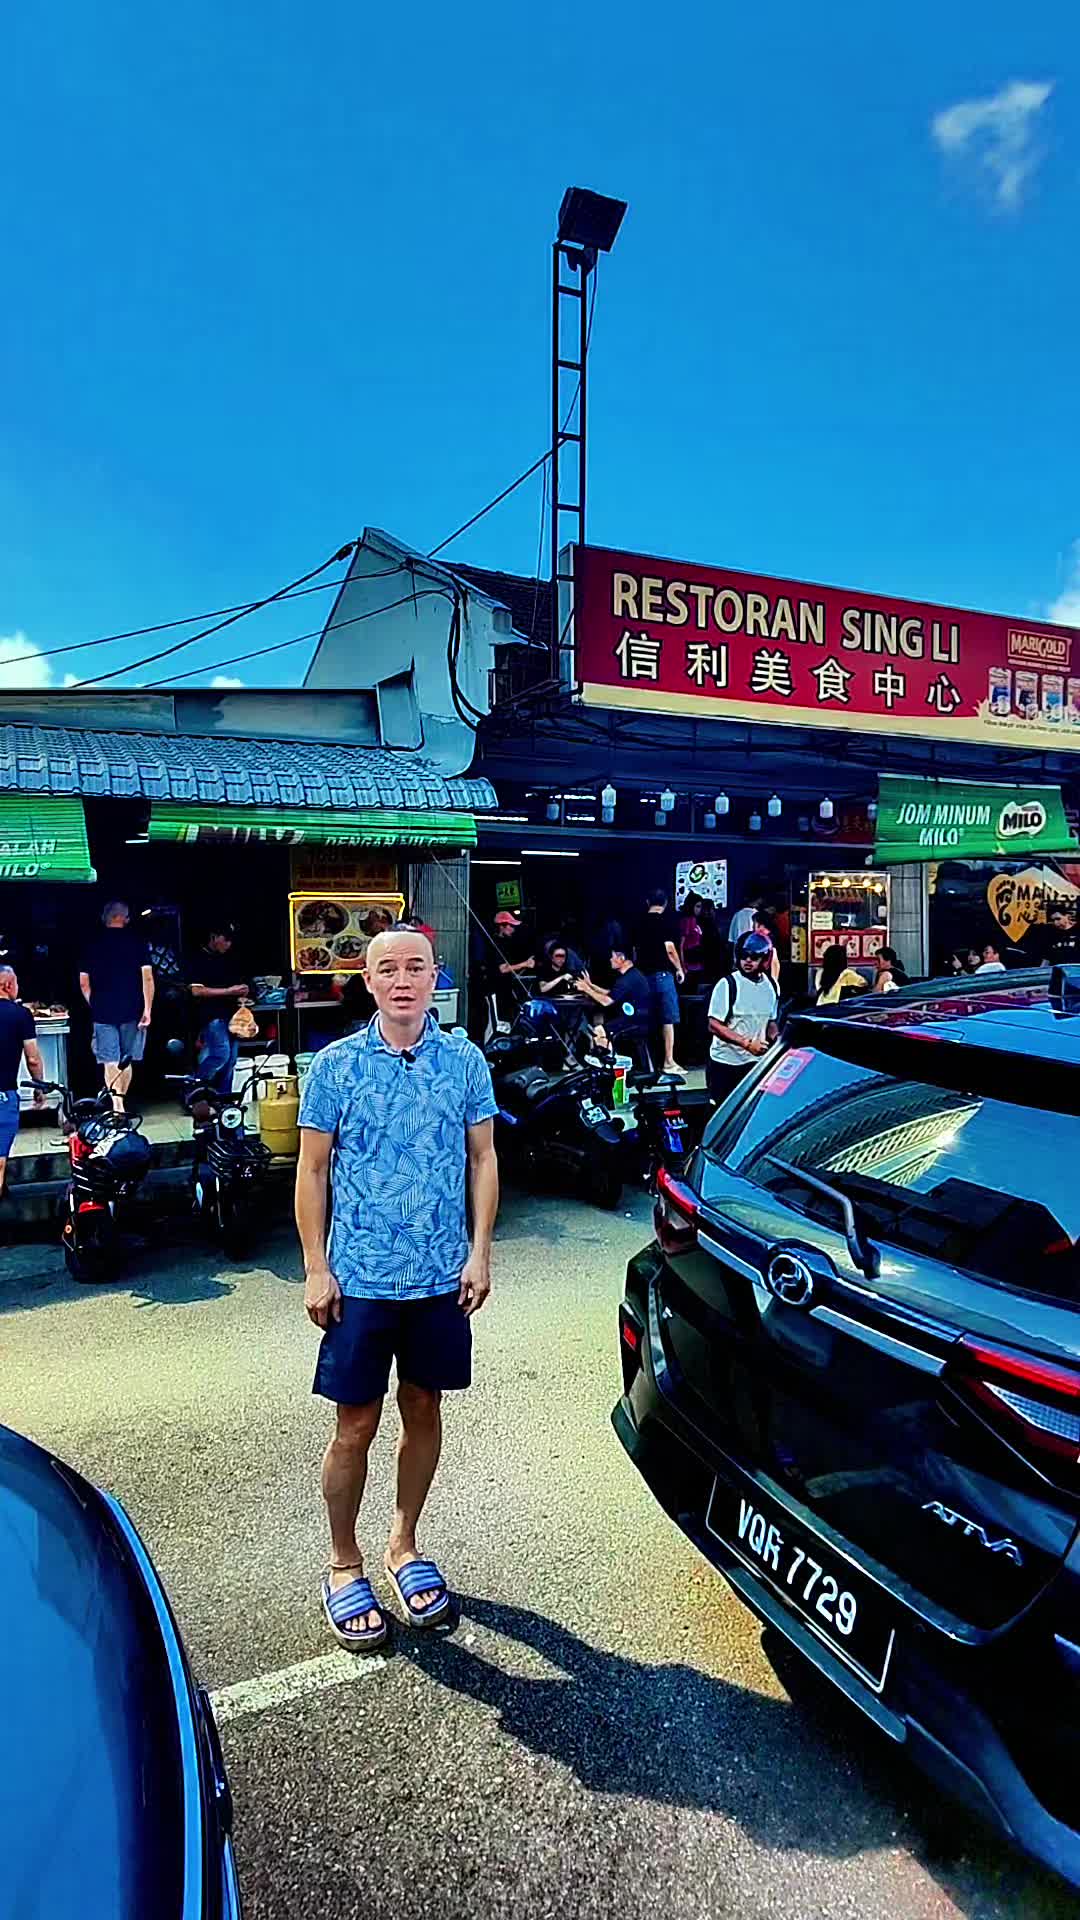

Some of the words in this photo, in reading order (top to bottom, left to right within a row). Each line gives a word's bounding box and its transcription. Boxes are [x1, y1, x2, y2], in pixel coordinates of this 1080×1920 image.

[613, 573, 824, 644] RESTORAN
[842, 609, 923, 658] SING
[932, 623, 958, 663] LI
[1011, 633, 1065, 657] MARIGOLD
[616, 631, 961, 713] 信利美食中心
[896, 803, 931, 824] JOM
[933, 805, 991, 825] MINUM
[1003, 812, 1042, 830] MILO
[786, 1546, 857, 1635] 7729
